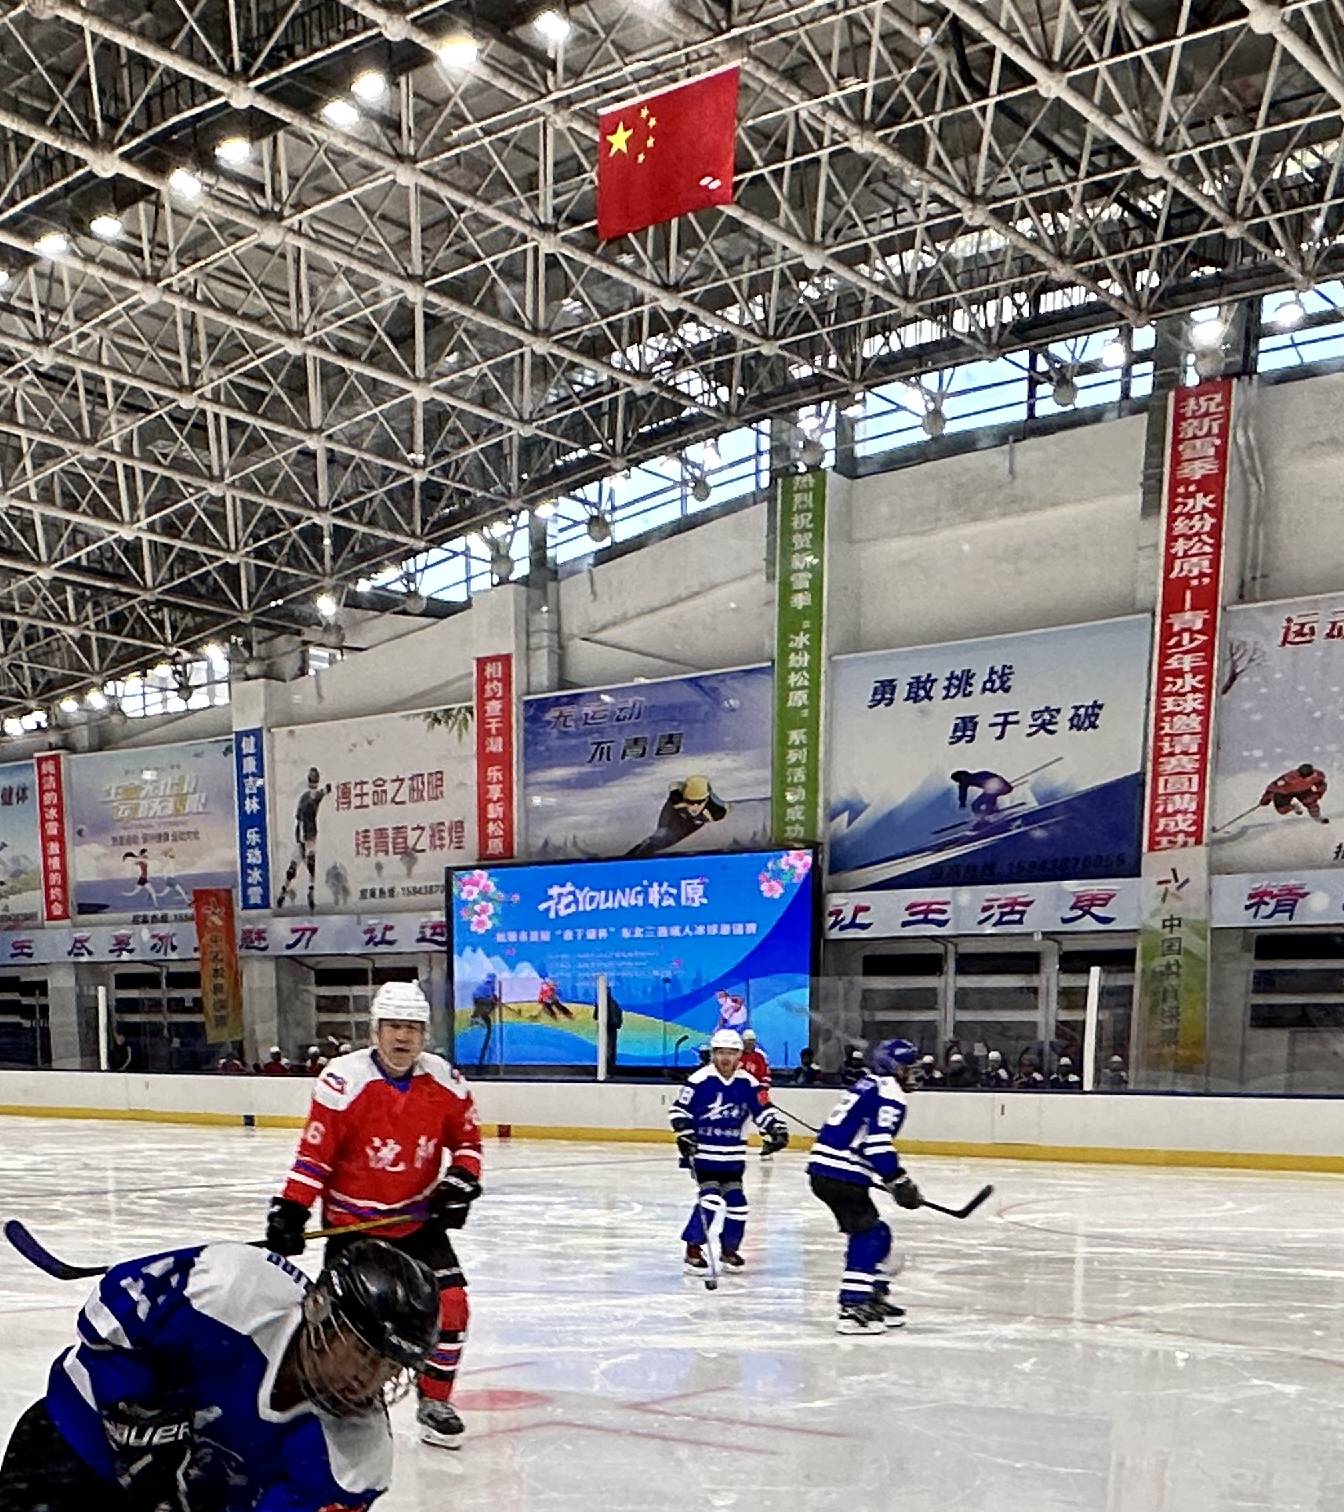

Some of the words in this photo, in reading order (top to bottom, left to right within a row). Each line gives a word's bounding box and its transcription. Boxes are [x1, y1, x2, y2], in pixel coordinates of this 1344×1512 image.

[484, 661, 504, 753] 相约查干湖
[867, 664, 1015, 709] 勇敢挑战
[948, 700, 1105, 745] 勇于突破
[241, 735, 261, 815] 健康吉林
